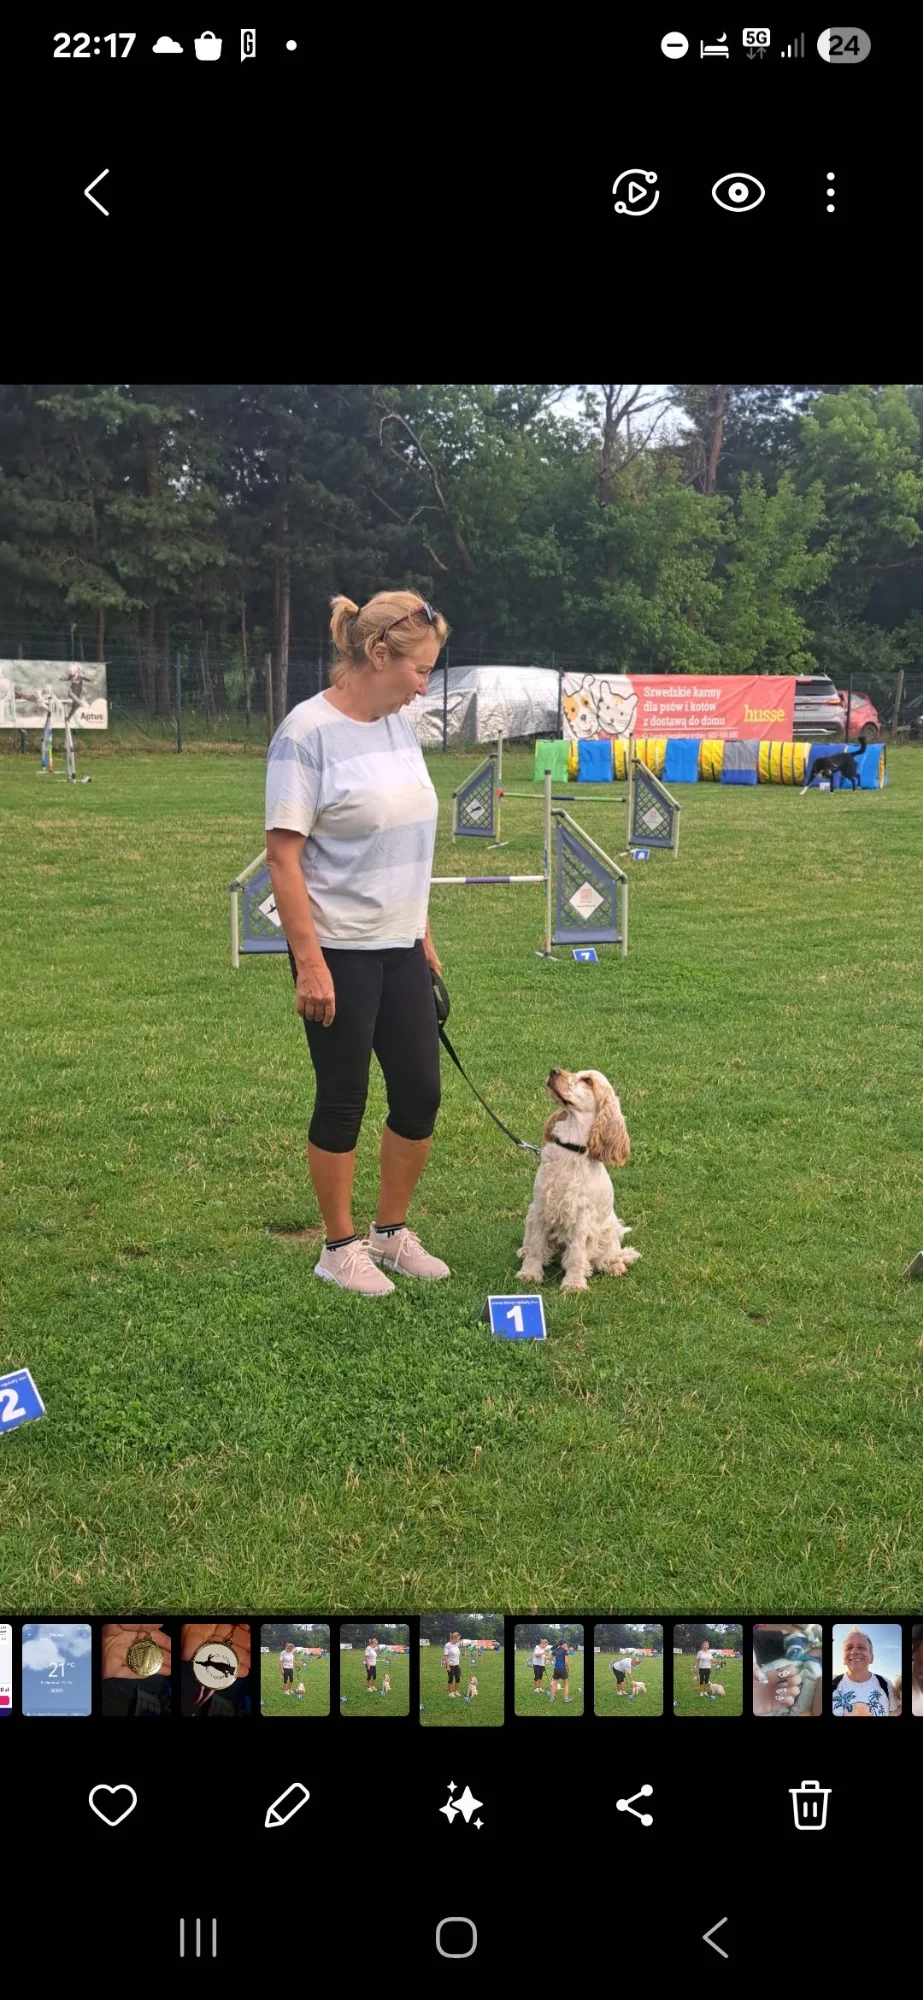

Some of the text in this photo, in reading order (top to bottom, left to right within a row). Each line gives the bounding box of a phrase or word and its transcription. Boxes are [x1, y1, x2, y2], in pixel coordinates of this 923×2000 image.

[53, 32, 137, 58] 22:17
[746, 30, 768, 45] 5G
[828, 35, 860, 56] 24
[644, 686, 722, 699] Szwedzkie karmy
[643, 701, 658, 712] dla
[660, 702, 684, 714] psów
[690, 702, 717, 712] kotów
[743, 704, 785, 723] husse
[80, 712, 104, 721] Aptus
[643, 716, 725, 728] z dostawą do domu
[581, 952, 590, 961] 7
[506, 1305, 524, 1332] 1
[0, 1388, 26, 1423] 2
